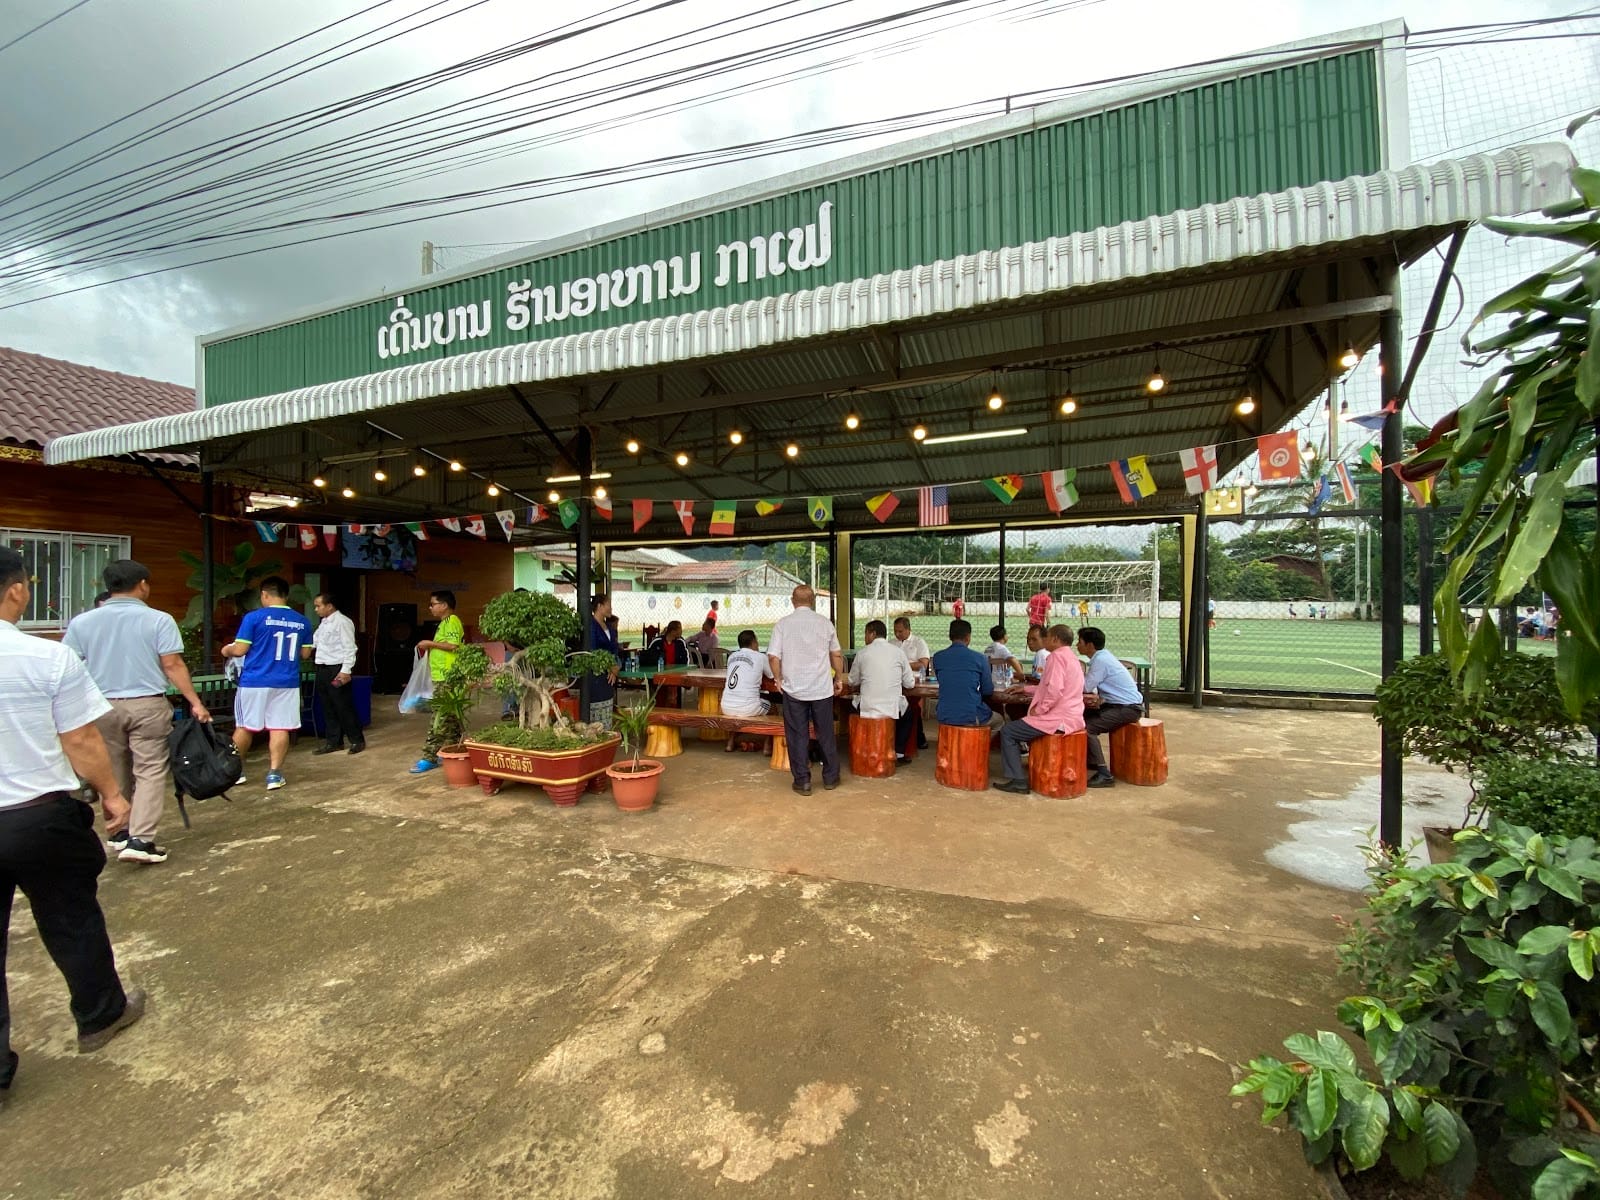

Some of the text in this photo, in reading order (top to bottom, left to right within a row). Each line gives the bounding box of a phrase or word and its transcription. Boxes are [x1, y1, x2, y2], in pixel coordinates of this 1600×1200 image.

[506, 251, 701, 331] ຮ້ານອາຫານ
[714, 200, 833, 287] ກາເຟ
[272, 631, 299, 661] 11
[727, 664, 740, 690] 6
